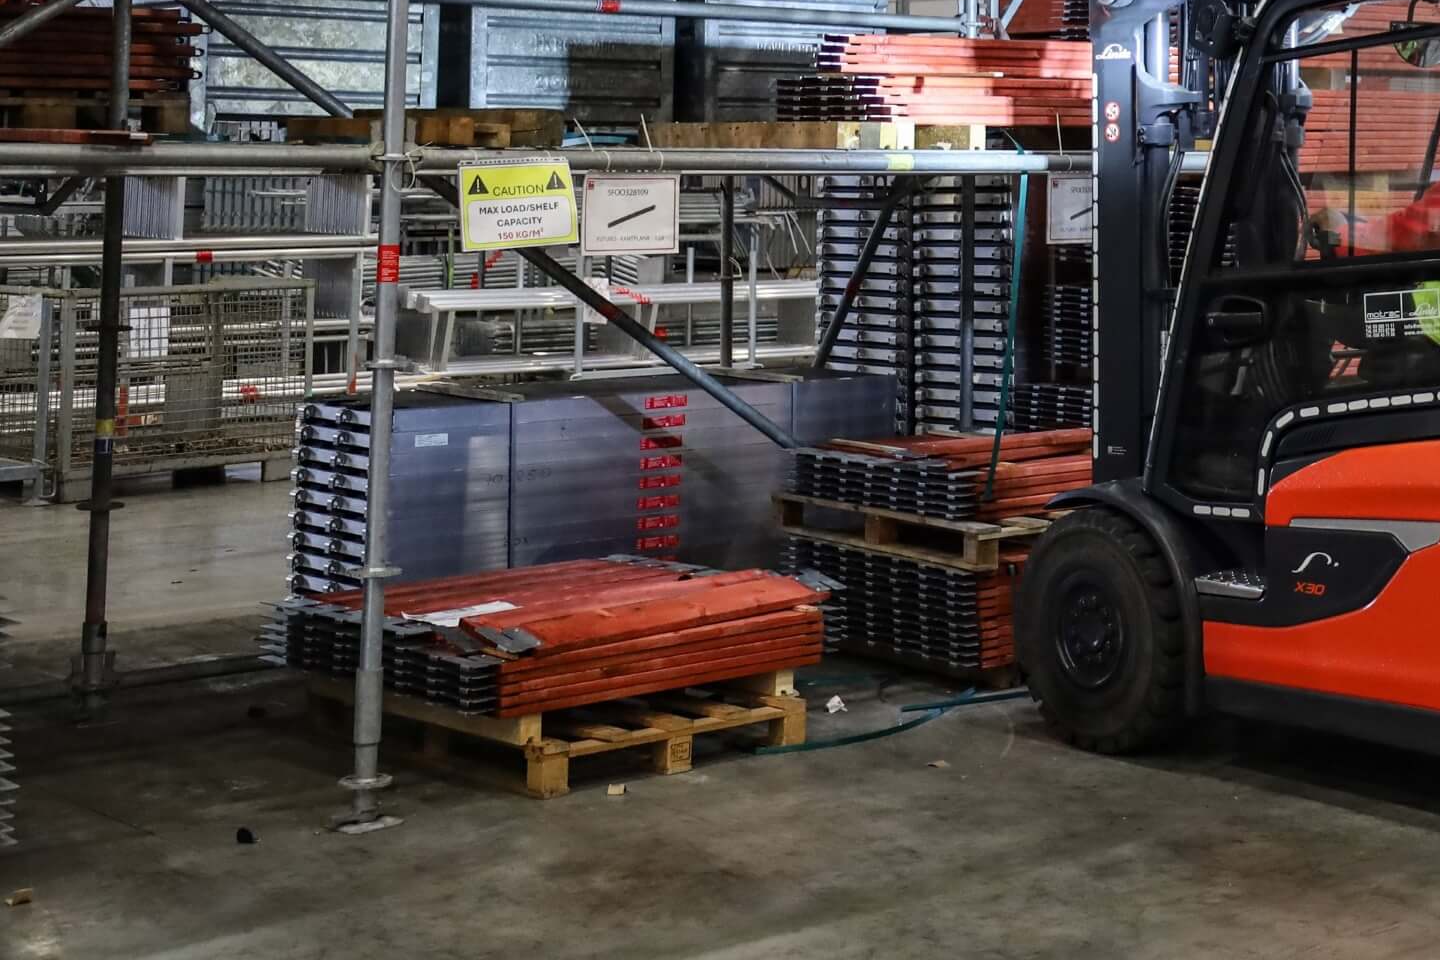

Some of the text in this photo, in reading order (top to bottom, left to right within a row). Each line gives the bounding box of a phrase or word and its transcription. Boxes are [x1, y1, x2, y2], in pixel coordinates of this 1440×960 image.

[1095, 43, 1131, 60] Linde
[492, 184, 544, 197] CAUTION
[479, 201, 560, 215] MAX LOAD/SHELF
[496, 216, 543, 228] CAPACITY
[498, 231, 514, 241] 150
[1366, 309, 1401, 320] motrac
[1294, 581, 1326, 596] X30
